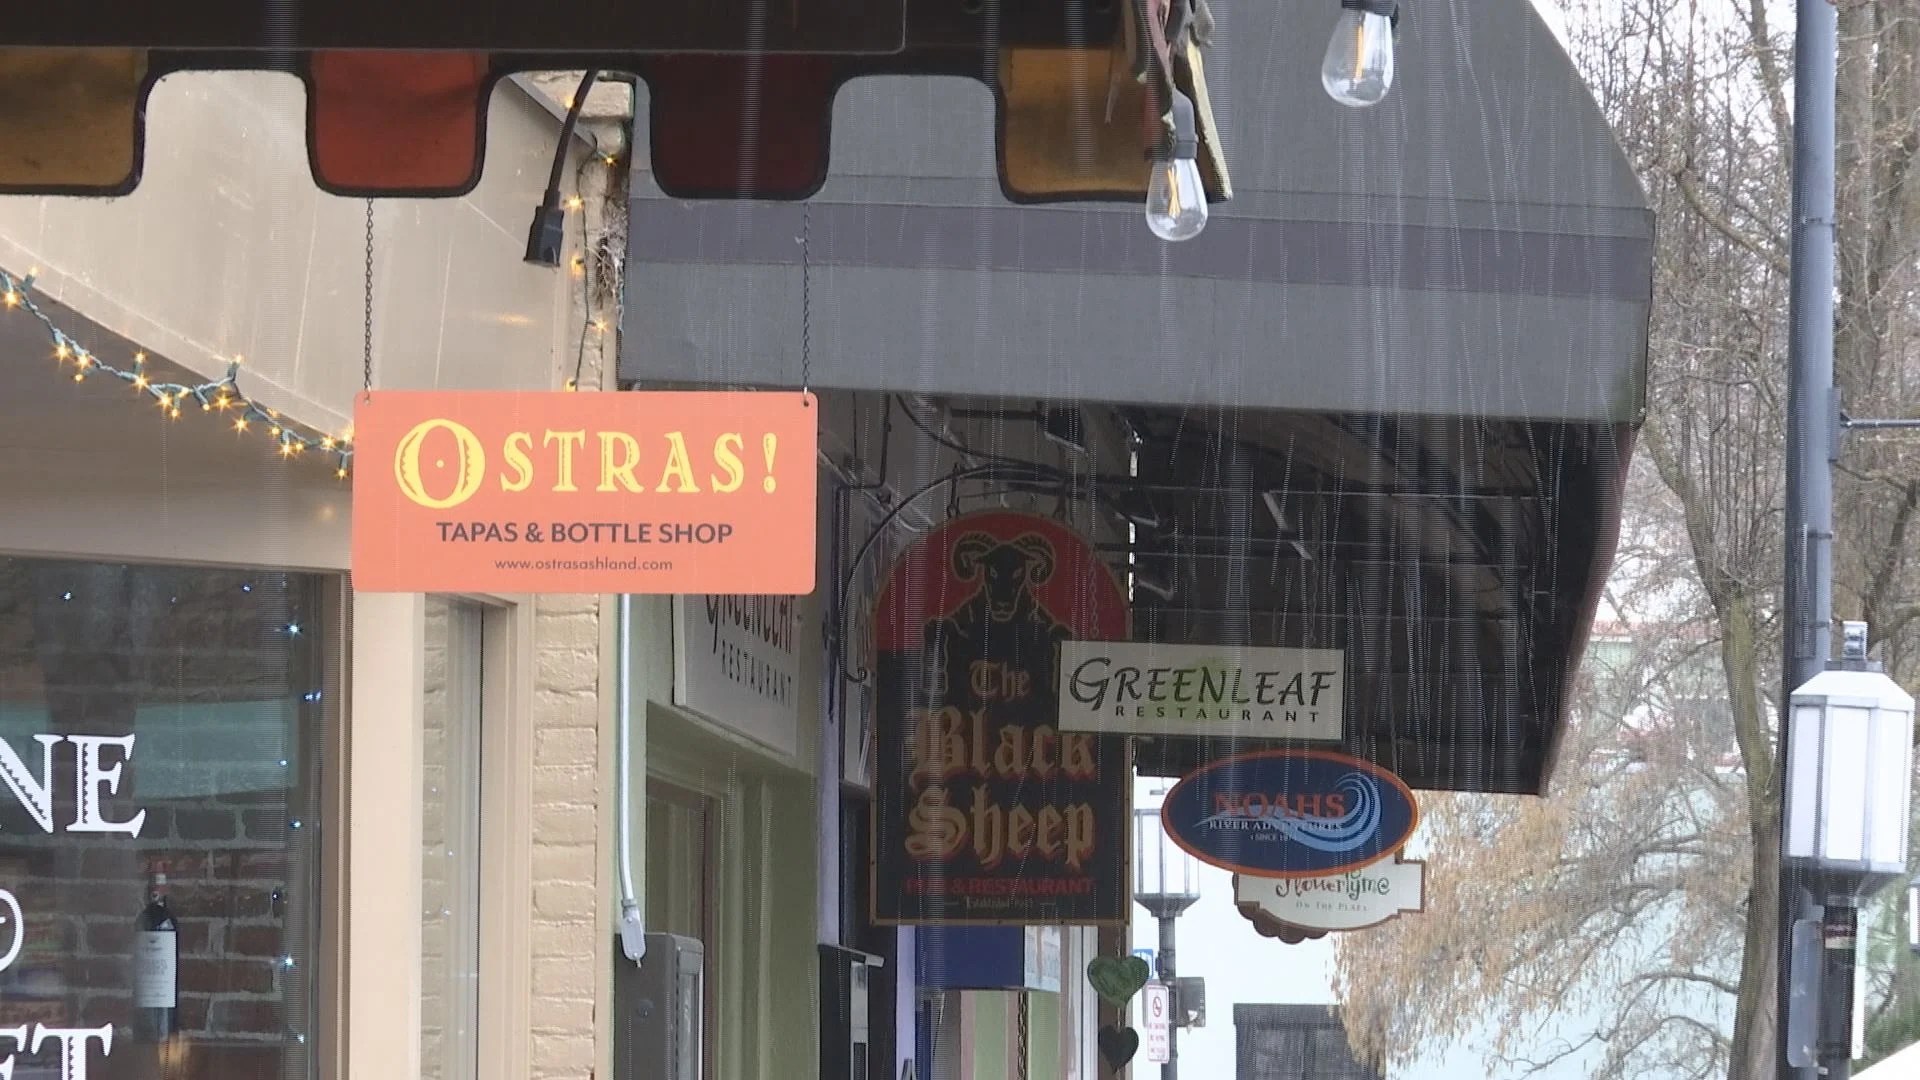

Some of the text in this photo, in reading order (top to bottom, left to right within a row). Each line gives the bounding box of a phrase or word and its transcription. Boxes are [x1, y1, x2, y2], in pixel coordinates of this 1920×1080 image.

[394, 418, 777, 508] OSTRAS!
[436, 522, 733, 544] TAPAS & BOTTLE SHOP
[494, 556, 673, 572] www.ostrasashland.com
[721, 638, 792, 707] RESTAURANT
[969, 658, 1031, 701] The
[1069, 657, 1337, 711] GREENLEAF
[1115, 705, 1319, 723] RESTAURANT
[1213, 791, 1346, 818] NOAHS
[904, 784, 1097, 869] Sheep
[1209, 819, 1249, 830] RIVER
[968, 878, 1095, 896] RESTAURANT
